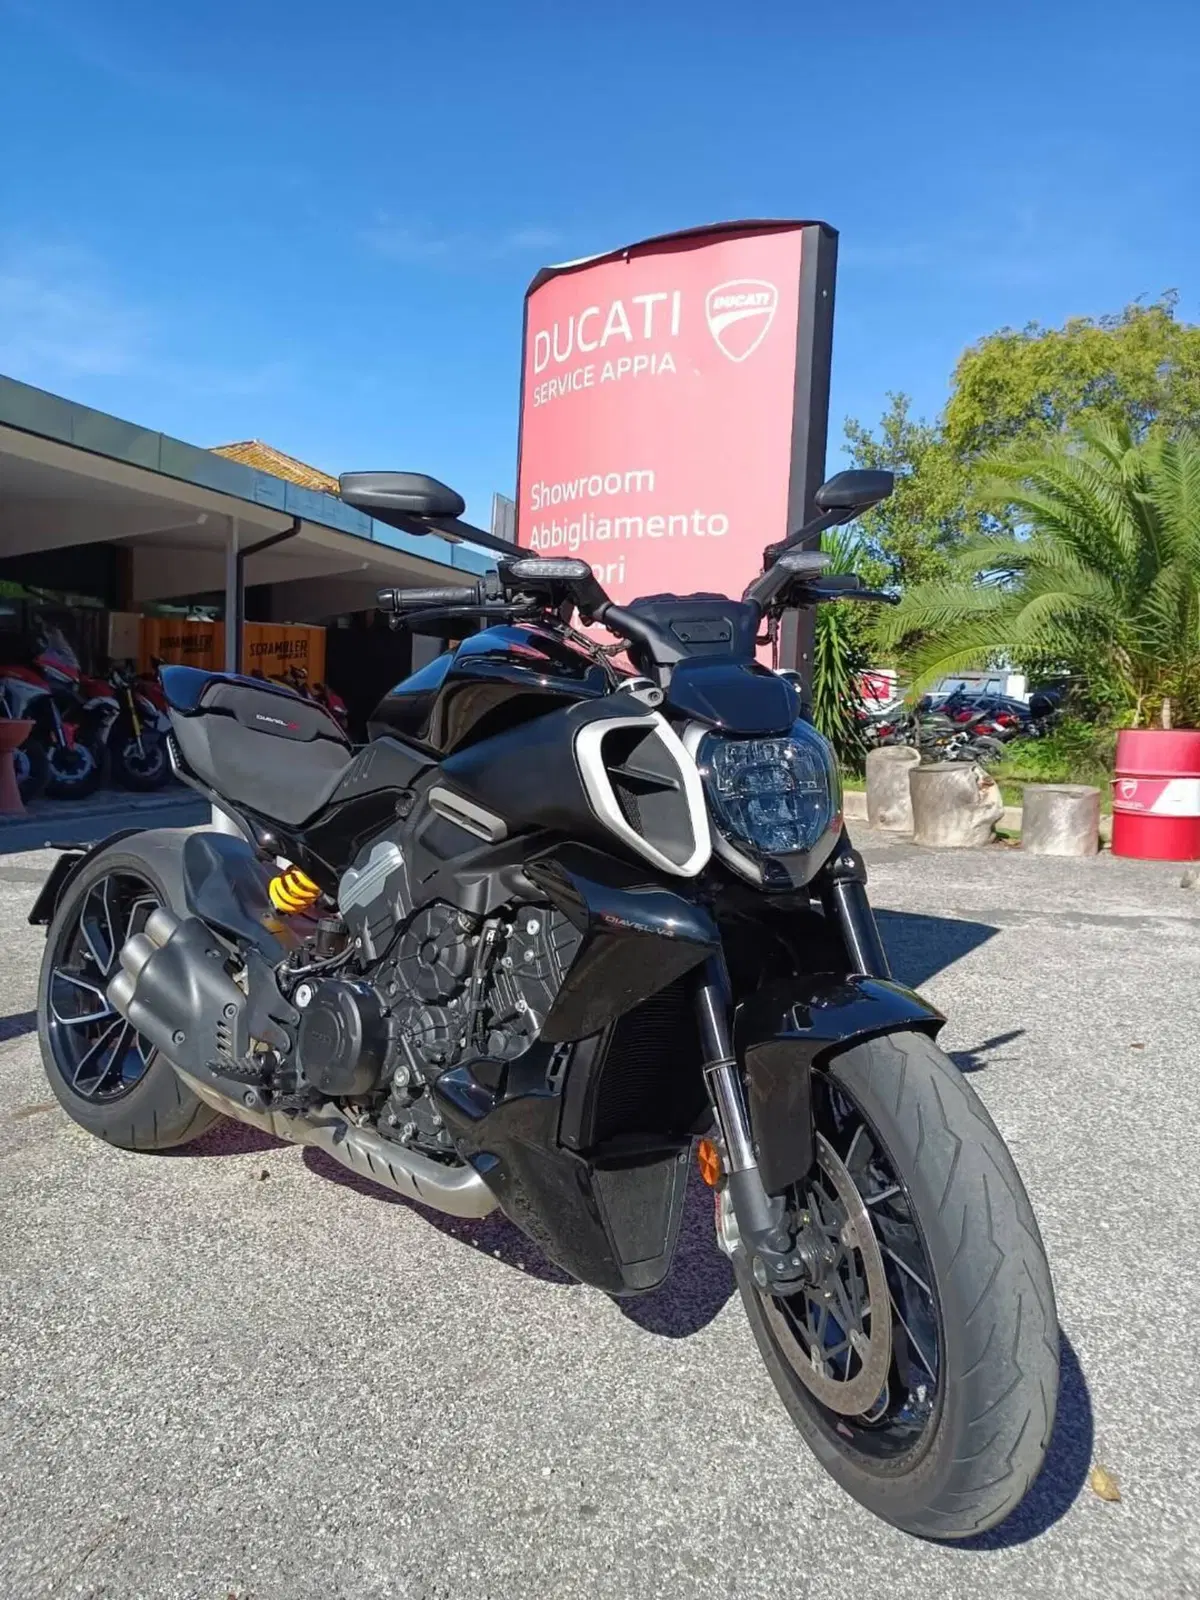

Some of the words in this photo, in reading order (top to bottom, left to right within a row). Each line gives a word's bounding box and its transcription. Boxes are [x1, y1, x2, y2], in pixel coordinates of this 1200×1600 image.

[713, 292, 770, 310] DUCATI
[534, 290, 680, 373] DUCATI
[533, 363, 595, 408] SERVICE
[599, 351, 677, 384] APPIA
[530, 468, 655, 511] Showroom
[529, 509, 729, 552] Abbigliamento
[249, 639, 308, 658] SCRAMBLER
